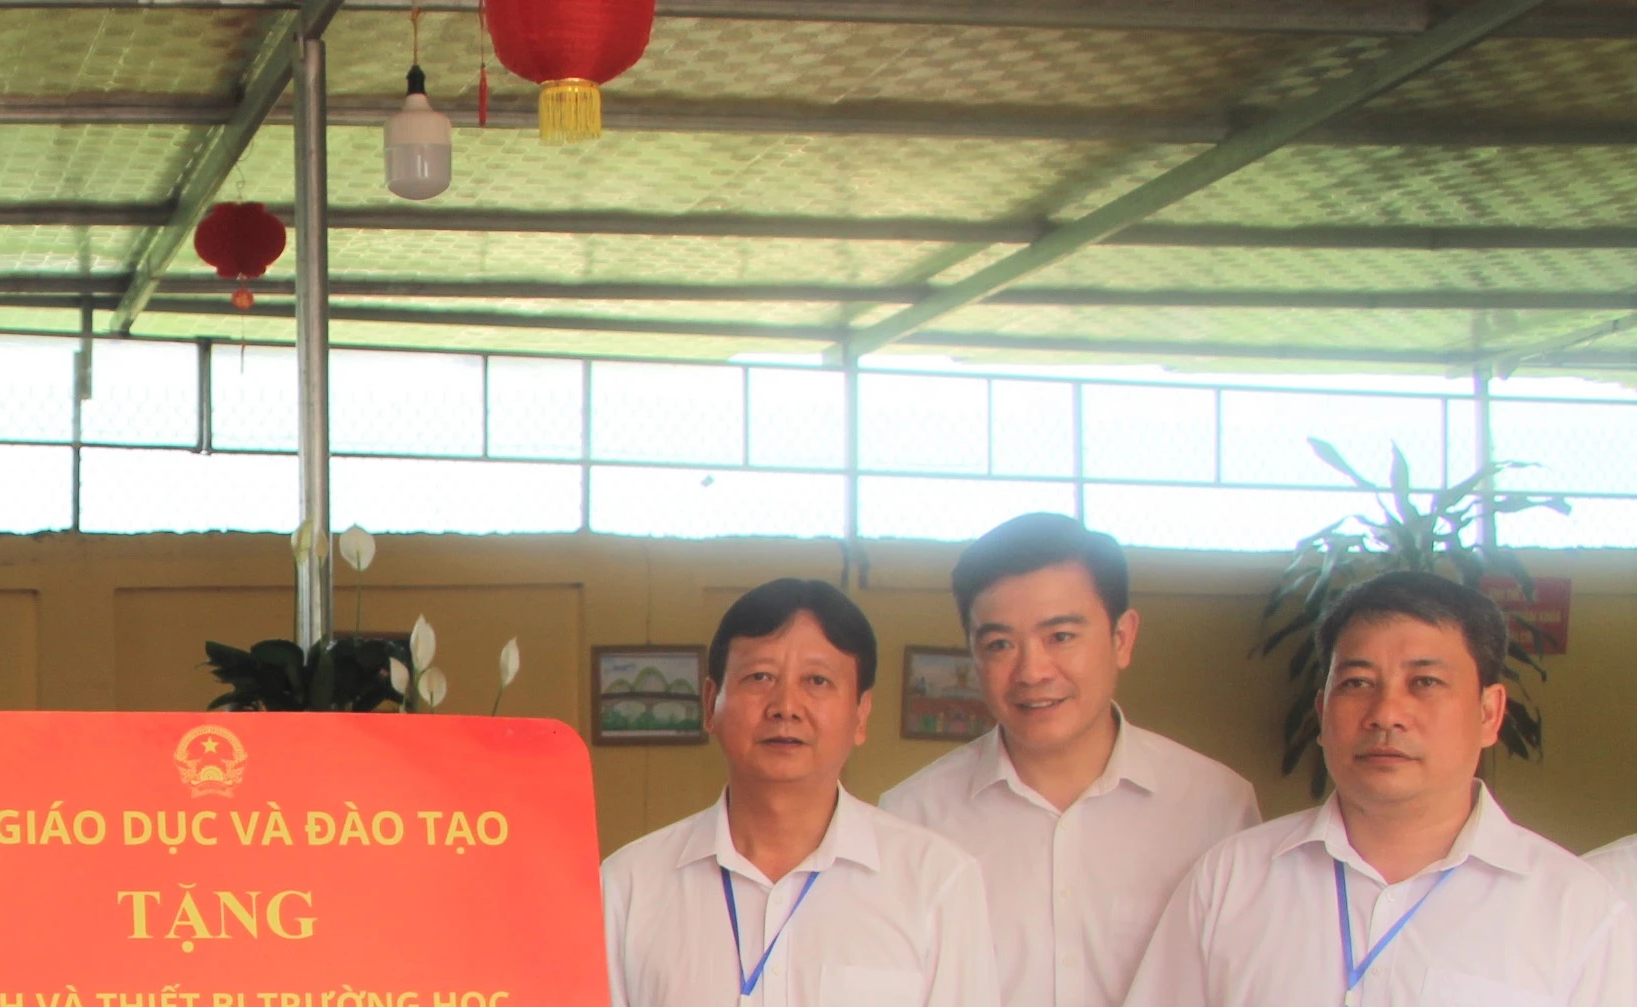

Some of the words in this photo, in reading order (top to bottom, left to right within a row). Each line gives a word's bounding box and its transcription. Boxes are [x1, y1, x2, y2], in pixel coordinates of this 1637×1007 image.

[123, 810, 218, 855] DỤC
[230, 801, 293, 846] VÀ
[304, 801, 404, 846] ĐÀO
[417, 811, 508, 855] TẠO
[117, 880, 317, 953] TẶNG
